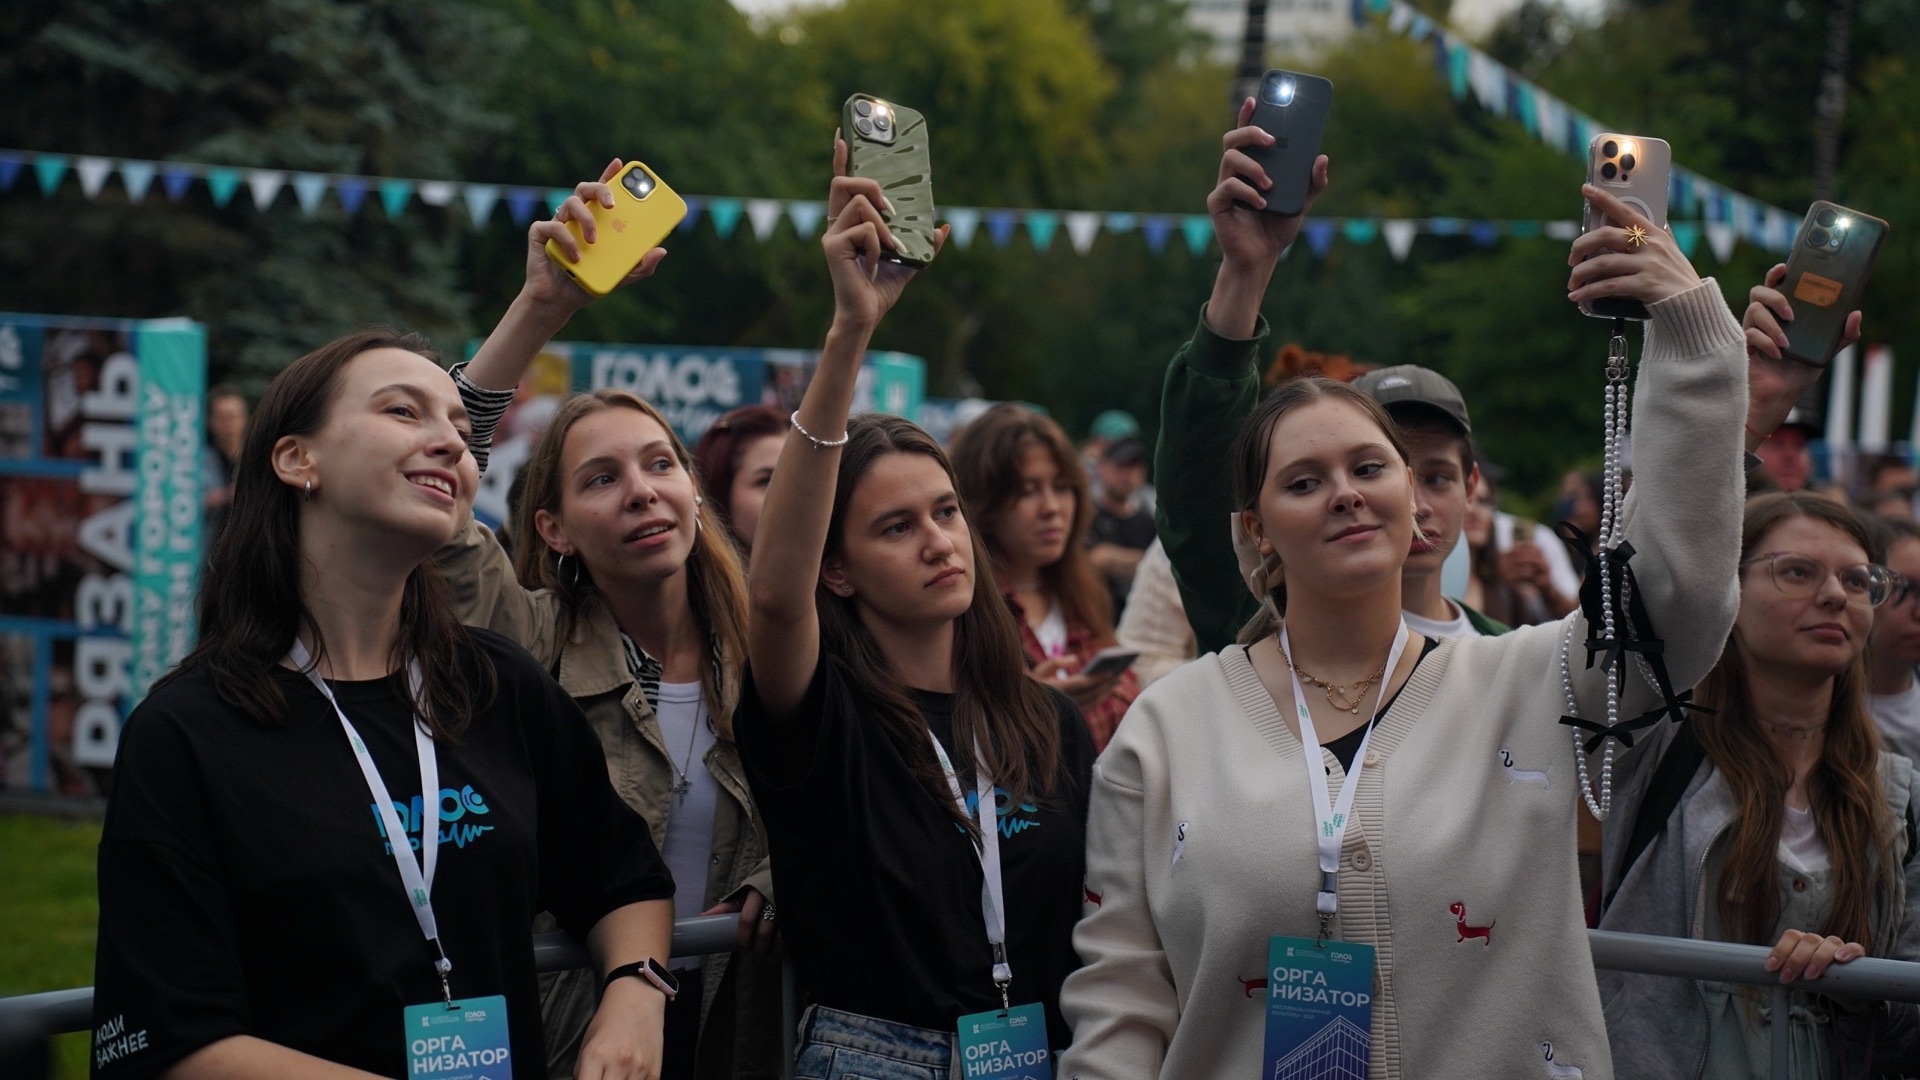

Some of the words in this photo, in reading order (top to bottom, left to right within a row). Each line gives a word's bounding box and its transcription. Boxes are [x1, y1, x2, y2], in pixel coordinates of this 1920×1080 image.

[73, 352, 141, 767] РЯЗАНЬ
[1273, 967, 1327, 986] ОРГА
[1272, 984, 1370, 1008] НИЗАТОР
[95, 1029, 149, 1070] ВАЖНЕЕ
[412, 1035, 466, 1056] ОРГА
[965, 1039, 1011, 1060] ОРГА
[413, 1047, 509, 1075] НИЗАТОР
[967, 1049, 1048, 1077] НИЗАТОР
